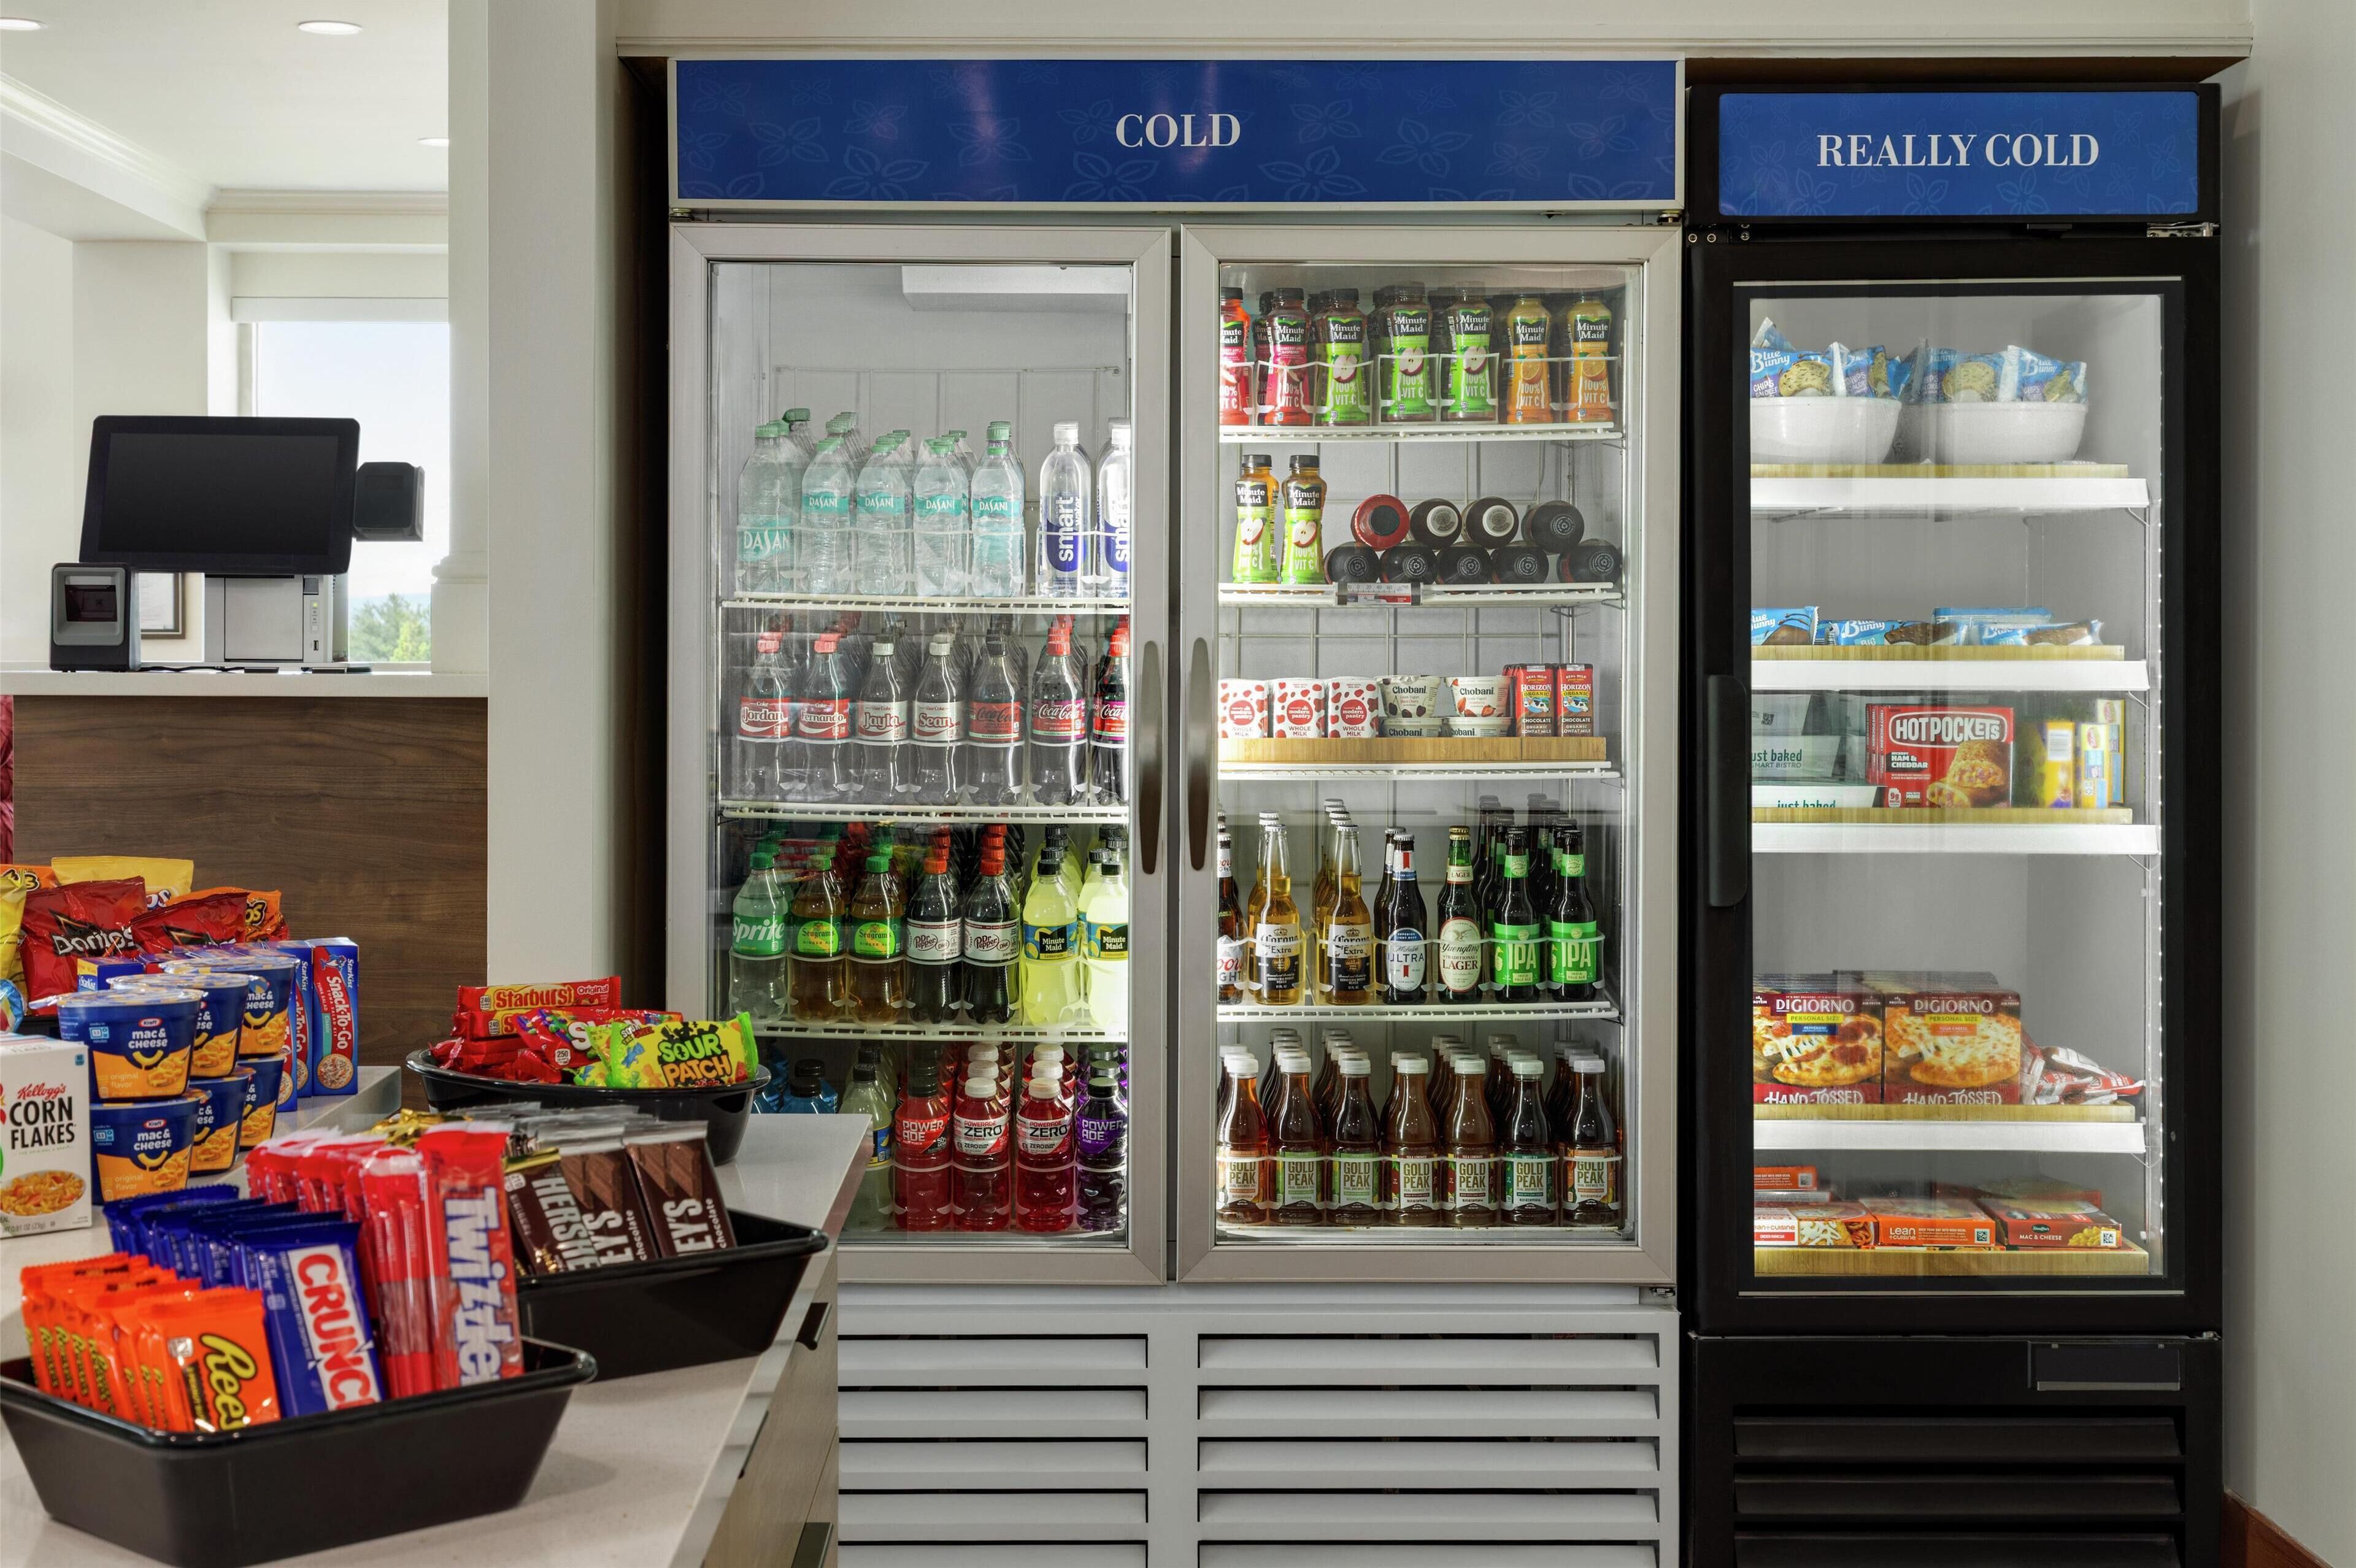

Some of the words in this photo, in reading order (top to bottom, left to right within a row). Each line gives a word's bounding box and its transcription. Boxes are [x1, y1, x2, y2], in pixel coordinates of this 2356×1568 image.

[1116, 113, 1241, 147] COLD
[1817, 134, 1977, 167] REALLY
[1985, 133, 2099, 167] COLD
[1396, 316, 1426, 325] Minute
[1460, 315, 1490, 324] Minute
[1330, 324, 1360, 332] Minute
[1401, 324, 1423, 332] Maid
[1465, 323, 1486, 331] Maid
[1334, 332, 1357, 340] Maid
[1403, 376, 1423, 386] 100%
[1466, 374, 1485, 383] 100%
[1336, 383, 1356, 393] 100%
[1466, 386, 1479, 397] VIT
[1522, 383, 1540, 394] 100%
[1585, 381, 1606, 391] 100%
[1753, 380, 1774, 392] CHIPS
[1403, 389, 1417, 398] VIT
[1584, 394, 1598, 403] VIT
[1336, 395, 1349, 405] VIT
[1521, 397, 1533, 406] VIT
[1237, 486, 1265, 497] Minute
[1290, 490, 1319, 498] Minute
[809, 495, 837, 508] DASANI
[865, 494, 893, 508] DASANI
[926, 499, 955, 512] DASANI
[979, 499, 1007, 512] DASANI
[1293, 498, 1315, 506] Maid
[1058, 496, 1074, 561] smart
[1295, 547, 1314, 558] 100%
[1295, 560, 1307, 571] VIT
[744, 707, 783, 723] Jordan
[801, 710, 844, 723] Fernando
[864, 712, 899, 730] Jayla
[919, 713, 952, 728] Sean
[1896, 717, 1928, 741] HOT
[1930, 717, 2000, 742] POCKETS
[1771, 749, 1802, 761] baked
[1890, 792, 1899, 801] 9g
[733, 917, 785, 942] Sprite
[52, 928, 133, 955] Doritos
[915, 936, 936, 949] Pepper
[977, 936, 998, 949] Pepper
[1441, 943, 1480, 954] Yuengling
[1388, 953, 1424, 963] ULTRA
[1508, 943, 1536, 970] IPA
[1562, 942, 1591, 968] IPA
[1443, 960, 1477, 970] LAGER
[265, 991, 274, 1000] &
[577, 985, 609, 995] Original
[495, 986, 573, 1009] Starburst
[1776, 999, 1854, 1012] DIGIORNO
[1915, 1000, 1993, 1013] DIGIORNO
[132, 1029, 158, 1040] mac
[158, 1028, 166, 1038] &
[659, 1033, 722, 1063] SOUR
[556, 1050, 569, 1059] 250
[663, 1054, 732, 1087] PATCH
[110, 1072, 138, 1082] original
[17, 1083, 66, 1102] Kellogg's
[9, 1097, 72, 1126] CORN
[903, 1120, 944, 1131] POWER
[964, 1125, 1002, 1137] ZERO
[1030, 1124, 1068, 1137] ZERO
[1082, 1120, 1124, 1131] POWER
[11, 1123, 75, 1150] FLAKES
[137, 1130, 161, 1141] mac
[162, 1129, 171, 1139] &
[903, 1131, 925, 1142] ADE
[1082, 1129, 1104, 1141] ADE
[1230, 1162, 1256, 1171] GOLD
[1288, 1161, 1314, 1172] GOLD
[1344, 1162, 1370, 1173] GOLD
[1404, 1163, 1430, 1175] GOLD
[1460, 1163, 1485, 1175] GOLD
[1517, 1162, 1543, 1175] GOLD
[1577, 1162, 1604, 1171] GOLD
[115, 1174, 143, 1183] original
[1230, 1172, 1256, 1184] PEAK
[1288, 1173, 1314, 1185] PEAK
[1344, 1174, 1370, 1187] PEAK
[1404, 1176, 1430, 1188] PEAK
[1460, 1176, 1485, 1188] PEAK
[1517, 1175, 1543, 1188] PEAK
[1577, 1171, 1604, 1184] PEAK
[706, 1197, 728, 1250] chocolate
